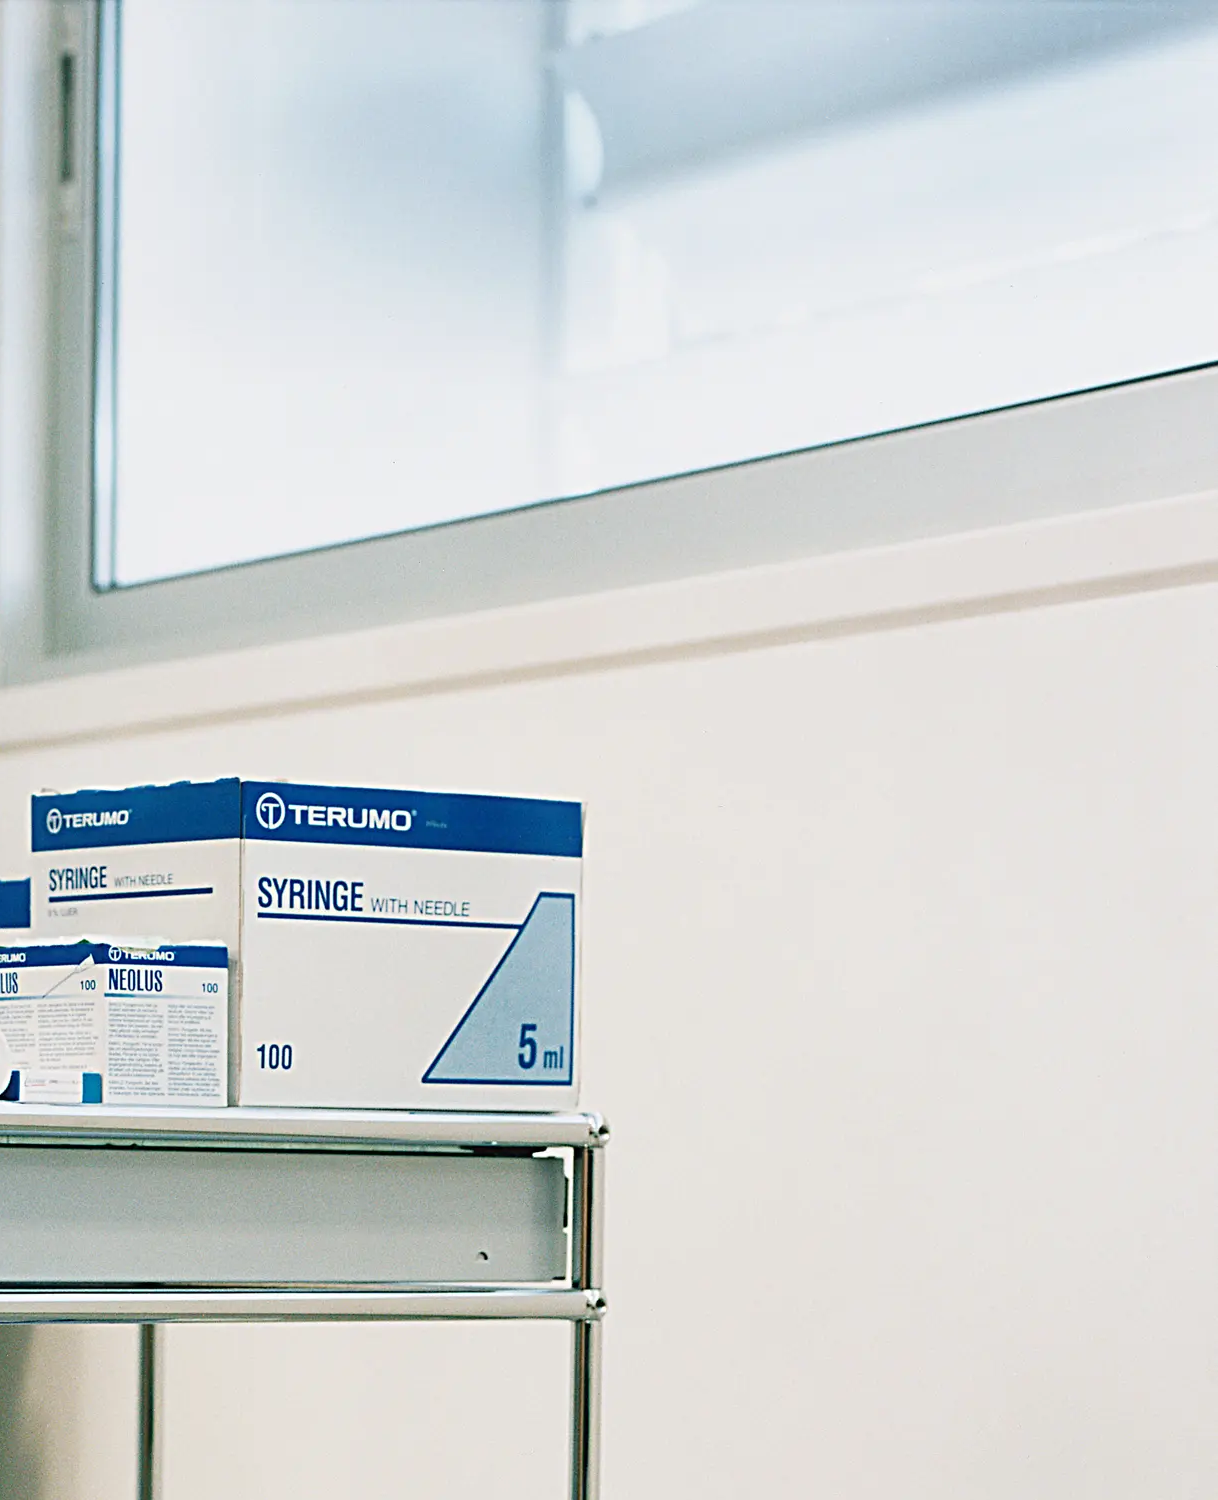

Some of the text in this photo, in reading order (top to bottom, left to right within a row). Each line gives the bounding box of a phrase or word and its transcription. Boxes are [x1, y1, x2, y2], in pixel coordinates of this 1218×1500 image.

[63, 810, 130, 829] TERUMO
[288, 804, 412, 832] TERUMO
[49, 866, 174, 891] SYRINGE WITH NEEDLE
[257, 876, 470, 917] SYRINGE WITH NEEDLE
[80, 979, 97, 991] 100
[108, 968, 219, 994] NEOLUS 100
[256, 1044, 293, 1070] 100
[518, 1023, 564, 1069] 5 ml
